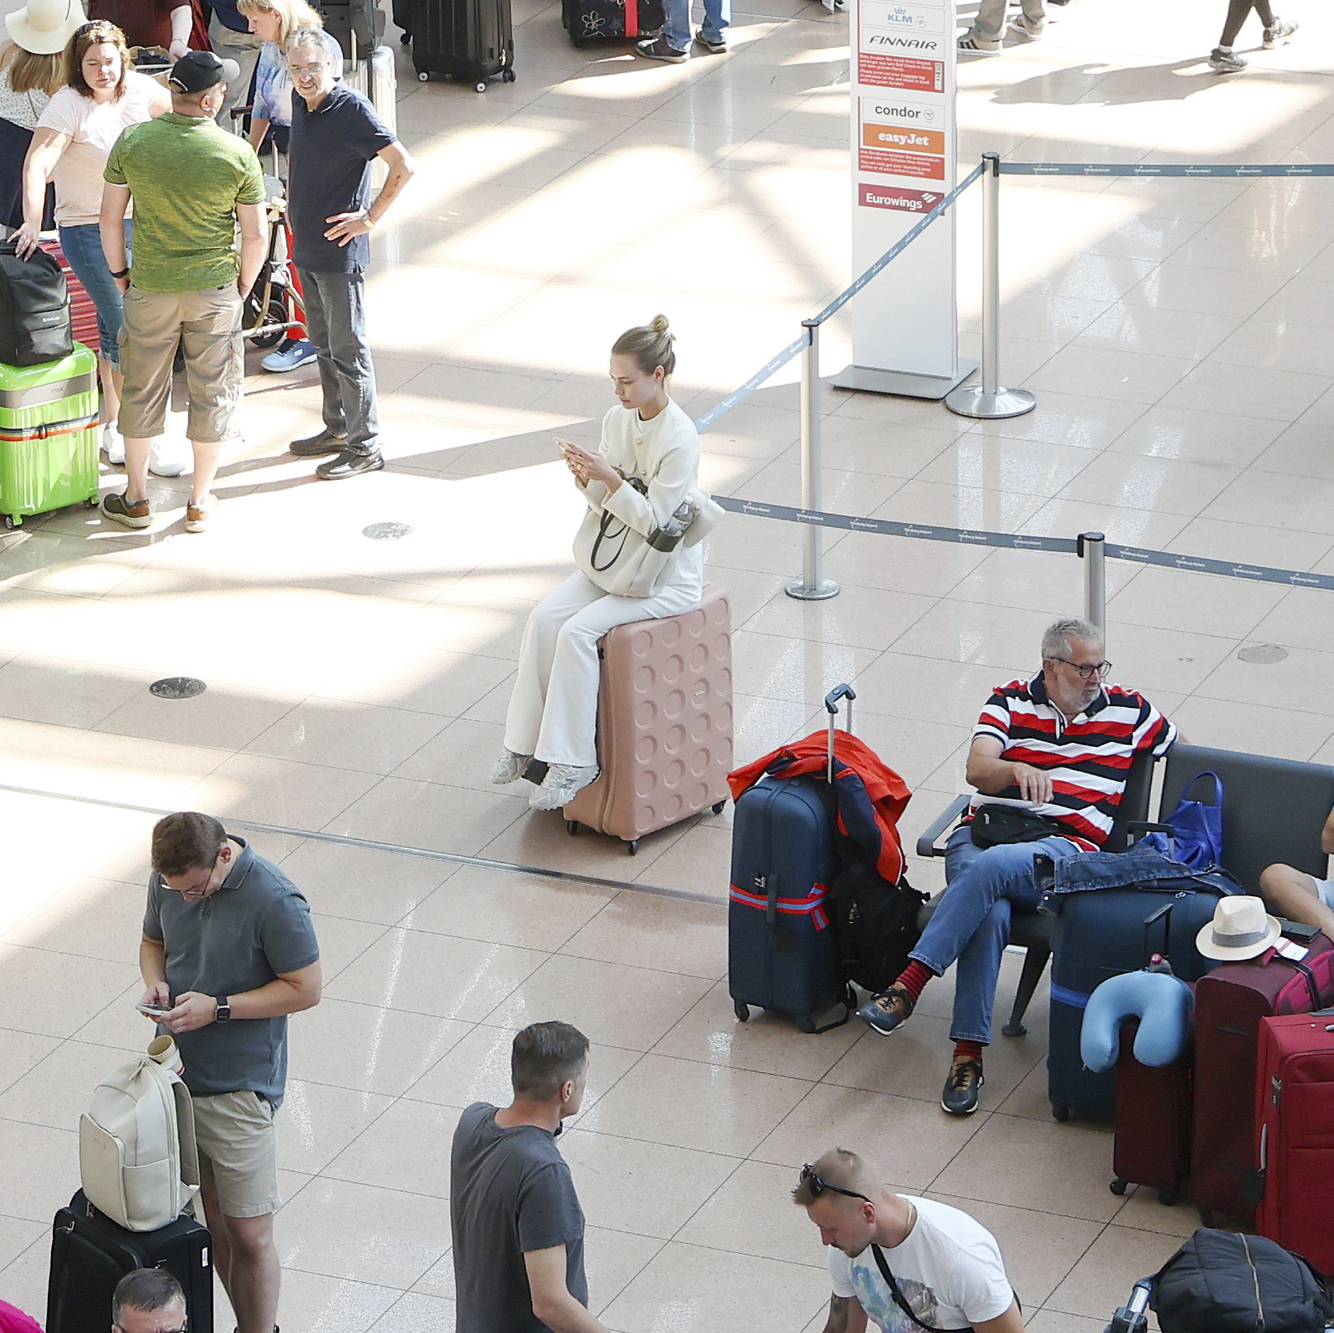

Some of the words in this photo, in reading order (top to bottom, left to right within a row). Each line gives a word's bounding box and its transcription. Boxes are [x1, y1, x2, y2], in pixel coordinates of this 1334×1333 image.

[888, 14, 912, 24] KLM
[870, 36, 938, 50] FINNAIR
[875, 106, 920, 118] condor
[878, 132, 930, 146] easyJet
[866, 192, 923, 210] Eurowings
